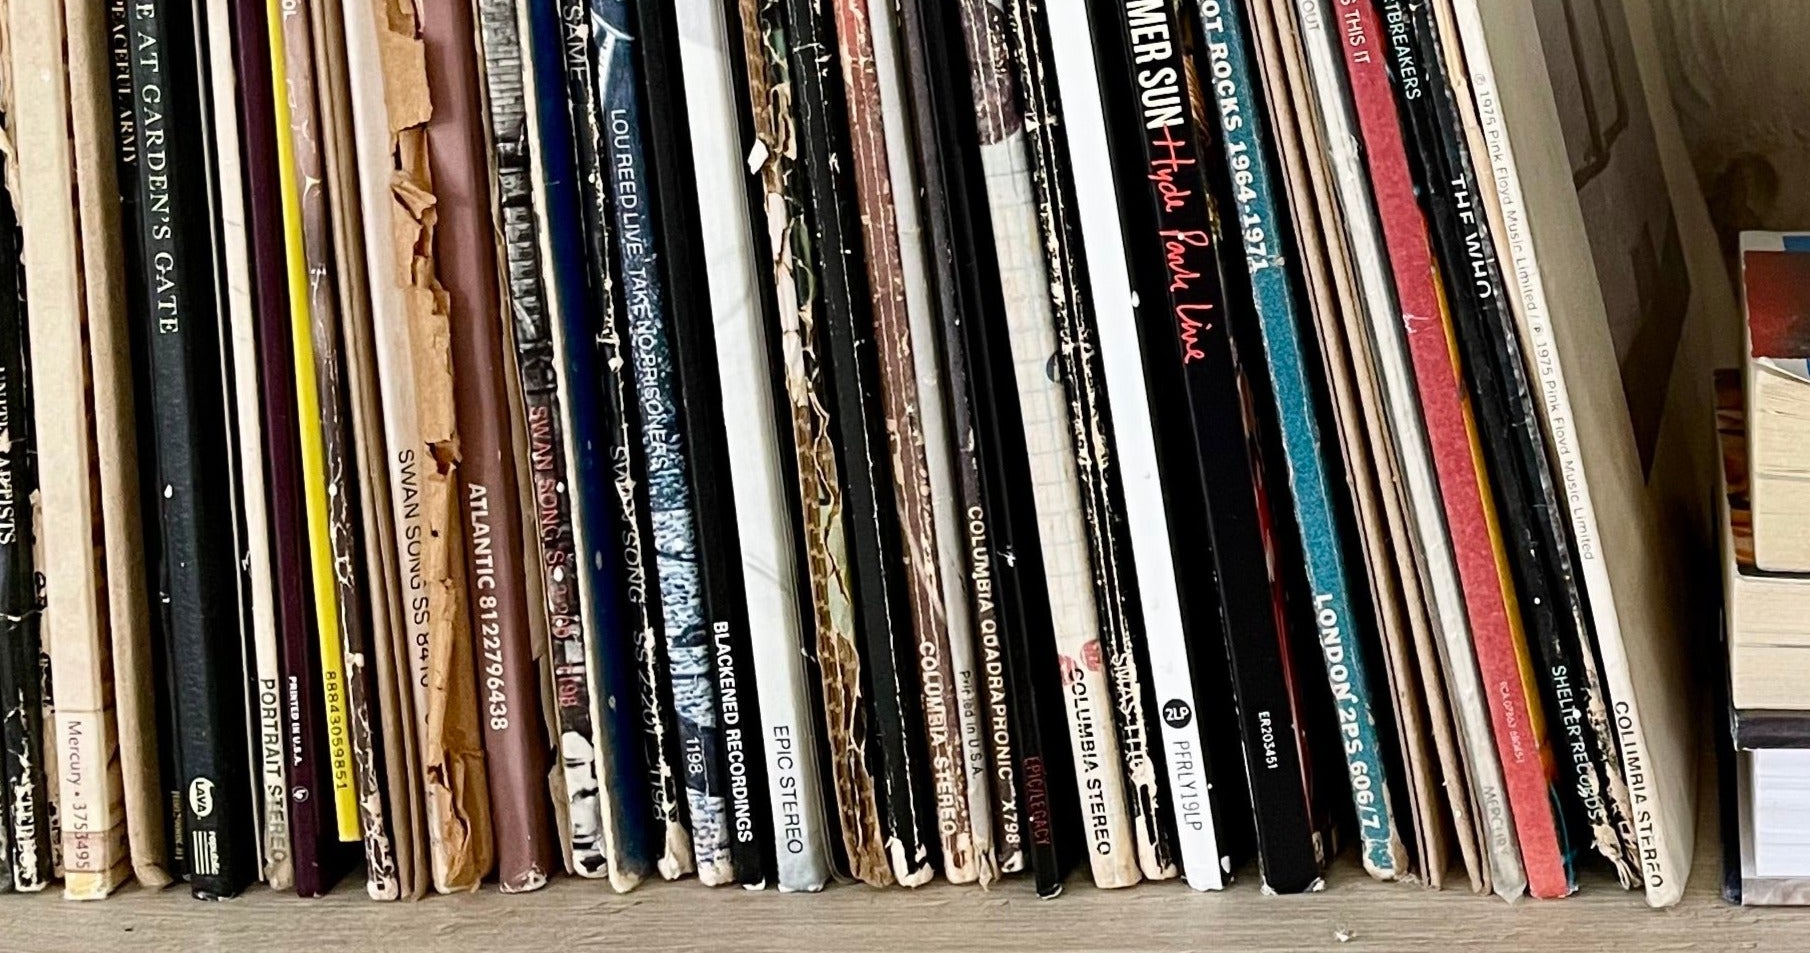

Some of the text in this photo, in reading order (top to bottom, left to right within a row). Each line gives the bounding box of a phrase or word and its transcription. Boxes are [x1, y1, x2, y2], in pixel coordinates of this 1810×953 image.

[137, 32, 159, 73] AT
[562, 5, 588, 81] SAME
[1340, 10, 1365, 46] THIS
[1352, 51, 1370, 64] IT
[120, 106, 138, 166] ARMY
[1137, 68, 1184, 130] SUN
[142, 85, 171, 240] GARDEN'S
[1148, 124, 1196, 212] Hyde
[1210, 43, 1241, 131] ROCKS
[1228, 140, 1269, 274] 1964-1971
[153, 253, 178, 335] GATE
[611, 109, 668, 469] LOU REED LIVE TAKE NO PRISONERS
[1158, 230, 1209, 292] Park
[1463, 233, 1491, 299] WHO
[1480, 91, 1596, 561] 1975 Pink Floyd 1975 Pink Music Limited
[530, 406, 561, 541] SWAN SONG
[398, 449, 430, 625] SWAN SS
[468, 483, 508, 730] ATLANTIC 8122796438
[287, 676, 302, 766] PRINTED IN U.S.A.
[966, 722, 979, 734] in
[968, 506, 1020, 844] COLUMBIA QUADRAPHONIC X798
[1165, 706, 1191, 722] 2LP
[1315, 593, 1380, 829] LONDON 2PS 606/7
[260, 679, 287, 863] PORTRAIT STEREO
[325, 671, 348, 792] 88843059851
[686, 736, 703, 774] 1198
[713, 622, 753, 842] BLACKENED RECORDINGS
[919, 641, 957, 836] COLUMBIA STEREO
[1069, 668, 1111, 855] COLUMBIA STEREO
[1258, 711, 1279, 769] ER203451
[1551, 665, 1581, 735] SHELTER
[1568, 741, 1602, 820] RECORDS
[67, 720, 90, 870] Mercury 3753495
[196, 781, 206, 812] LAVA
[772, 725, 803, 854] EPIC STEREO
[1023, 756, 1051, 846] EPIC/LEGACY
[1172, 740, 1202, 831] PFRLY19LP
[1614, 701, 1664, 888] COLUMBIA STEREO
